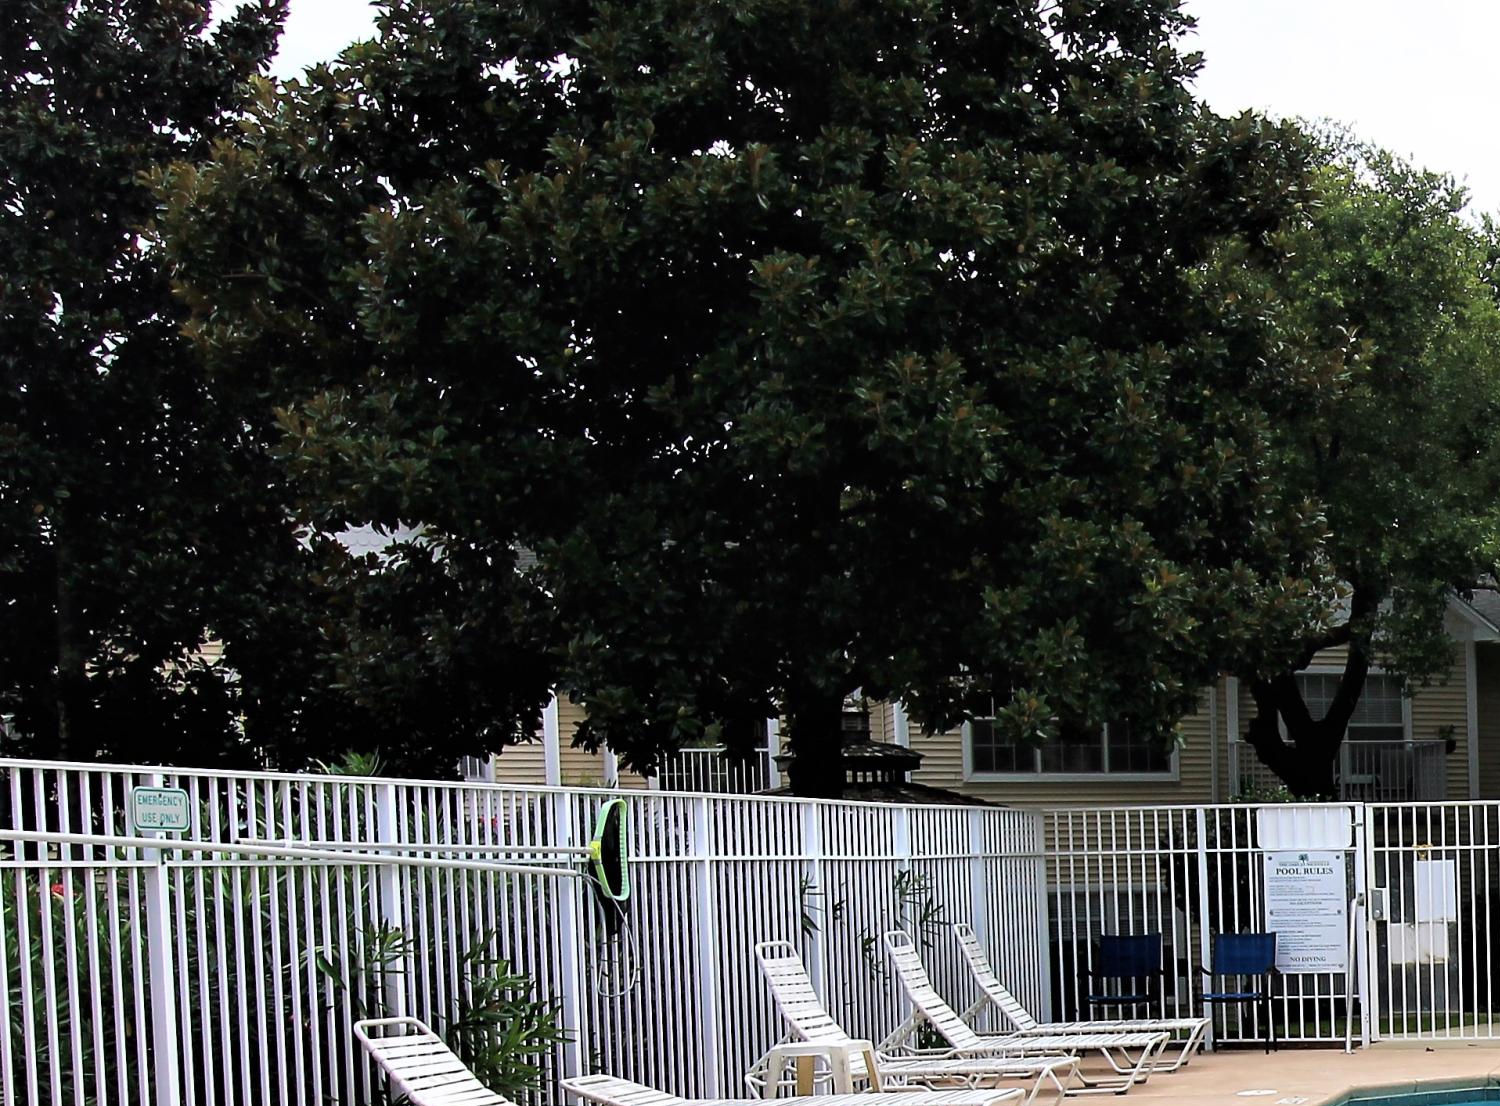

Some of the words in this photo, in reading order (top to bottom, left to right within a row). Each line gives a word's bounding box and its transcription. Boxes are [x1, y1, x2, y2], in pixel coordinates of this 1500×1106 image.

[138, 795, 183, 806] EMERGENCY
[142, 812, 157, 823] USE
[160, 813, 180, 823] ONLY
[1276, 867, 1302, 876] POOL
[1304, 866, 1334, 875] RULES
